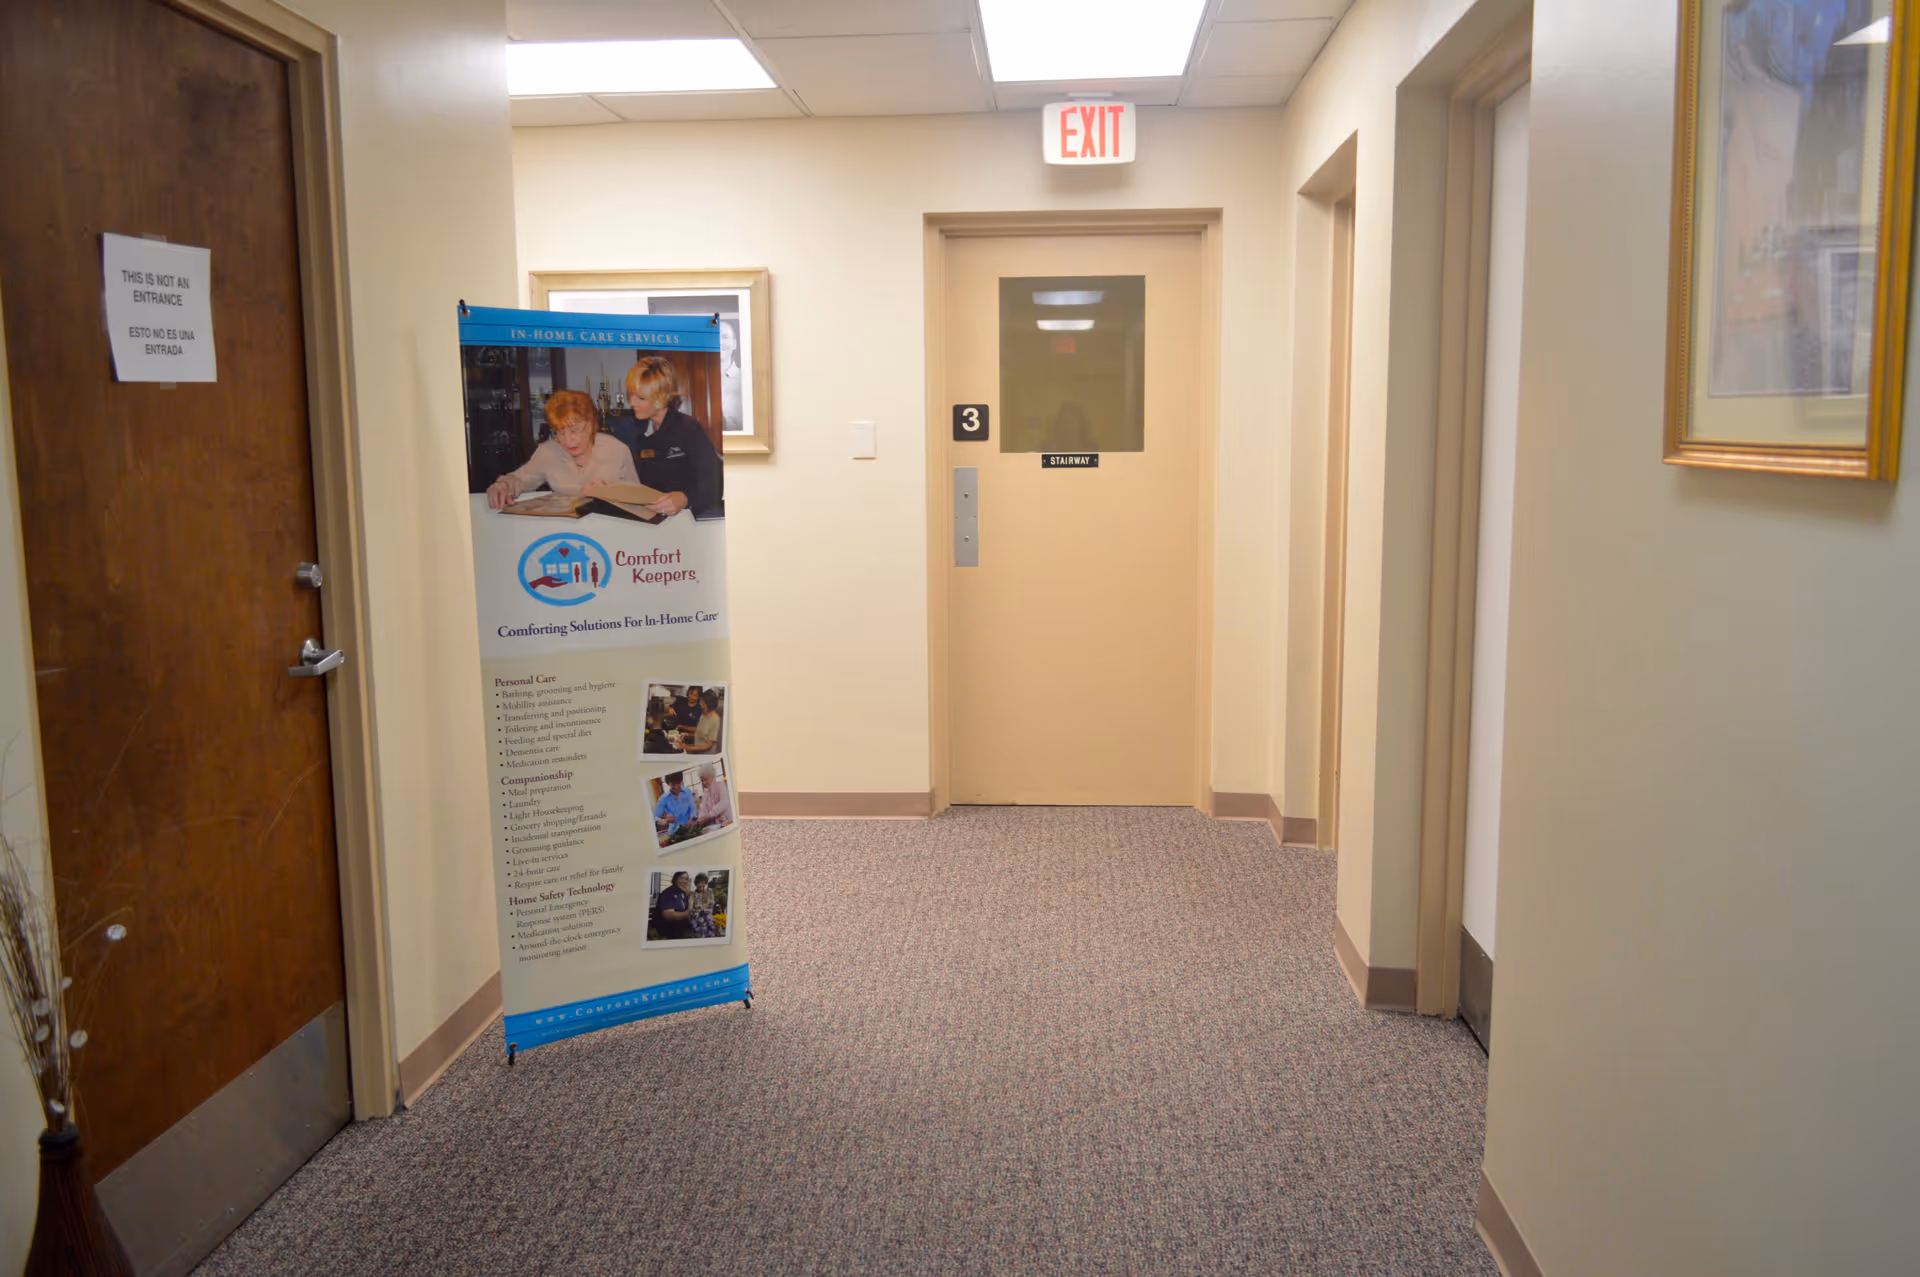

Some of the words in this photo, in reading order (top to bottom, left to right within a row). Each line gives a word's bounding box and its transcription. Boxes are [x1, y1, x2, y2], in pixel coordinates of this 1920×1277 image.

[1059, 105, 1124, 158] EXIT
[121, 270, 143, 284] THIS
[145, 273, 154, 285] IS
[156, 274, 174, 287] NOT
[177, 277, 190, 289] AN
[133, 290, 183, 306] ENTRANCE
[129, 327, 151, 338] ESTO
[153, 329, 165, 339] NO
[167, 329, 177, 340] ES
[180, 330, 195, 340] UNA
[511, 329, 574, 340] IN-HOME
[580, 331, 614, 341] CARE
[620, 333, 679, 343] SERVICES
[145, 344, 183, 355] ENTRADA
[962, 408, 980, 431] 3
[615, 548, 681, 566] Comfort
[632, 568, 696, 586] Keepers
[497, 621, 568, 637] Comforting
[570, 618, 622, 633] Solutions
[625, 616, 643, 628] For
[646, 613, 693, 627] In-Home
[695, 611, 719, 622] Care
[495, 675, 533, 687] Personal
[536, 674, 556, 683] Care
[536, 686, 572, 697] grooming
[574, 682, 587, 691] and
[588, 681, 616, 691] hygiene
[502, 701, 535, 710] Mobility
[538, 699, 572, 707] assistance
[504, 712, 549, 722] Transferring
[551, 708, 564, 717] and
[566, 705, 606, 718] positioning
[504, 725, 538, 734] Toileting
[540, 721, 553, 730] and
[556, 718, 601, 728] incontinence
[505, 736, 535, 745] Feeding
[537, 732, 550, 741] and
[552, 730, 576, 743] special
[578, 729, 592, 737] diet
[505, 747, 543, 757] Dementia
[506, 758, 549, 768] Medication
[552, 752, 587, 763] reminders
[501, 770, 573, 786] Companionship
[508, 788, 527, 796] Meal
[530, 783, 571, 796] preparation
[509, 799, 541, 808] Laundry
[510, 811, 530, 821] Light
[533, 805, 584, 817] Housekeeping
[510, 822, 540, 831] Grocery
[543, 810, 606, 827] shopping/Errands
[511, 832, 548, 843] Incidental
[551, 825, 601, 837] transportation
[552, 839, 584, 850] guidance
[513, 857, 539, 866] Live-in
[542, 853, 568, 861] services
[513, 868, 544, 877] 24-hour
[515, 881, 541, 889] Respite
[544, 877, 558, 885] care
[570, 871, 587, 879] relief
[589, 869, 599, 877] for
[602, 865, 623, 874] family
[509, 896, 537, 906] Home
[540, 890, 565, 901] Safety
[567, 882, 616, 896] Technology
[516, 905, 546, 917] Personal
[549, 900, 588, 911] Emergency
[517, 918, 551, 928] Response
[553, 912, 576, 921] system
[517, 927, 560, 939] Medication
[561, 921, 593, 931] solutions
[584, 928, 621, 938] emergency
[519, 951, 560, 962] monitoring
[563, 945, 586, 953] station
